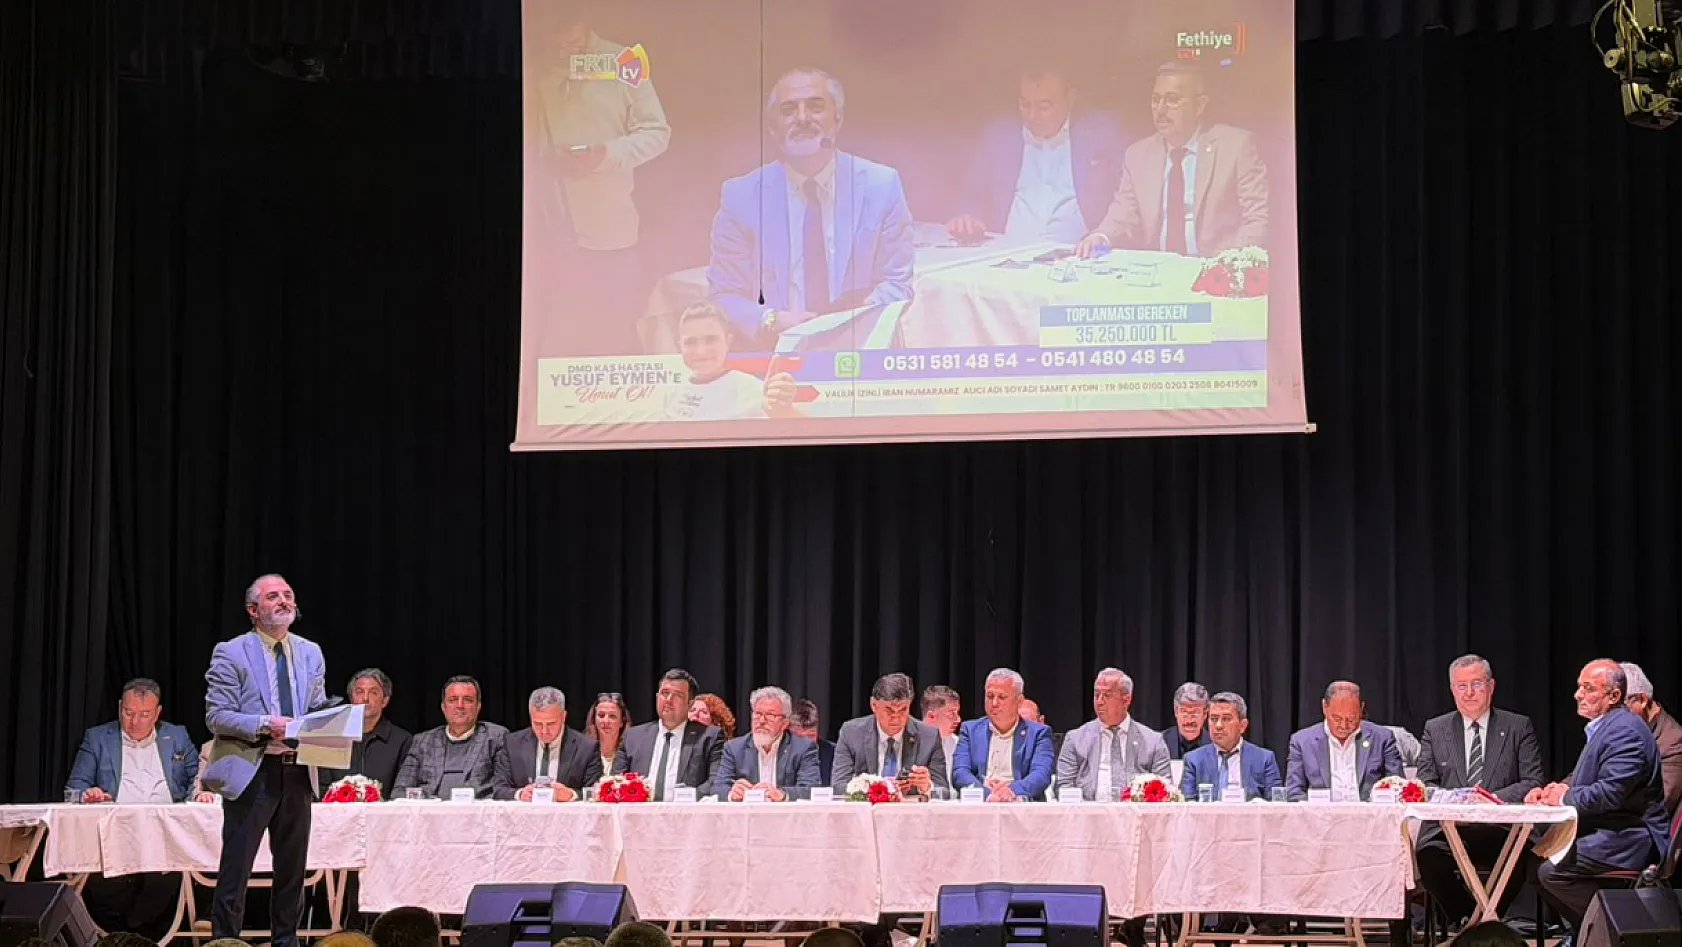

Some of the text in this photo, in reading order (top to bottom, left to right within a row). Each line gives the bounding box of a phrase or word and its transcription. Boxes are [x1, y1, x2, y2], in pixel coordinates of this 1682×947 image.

[1177, 30, 1233, 49] Fethiye
[569, 53, 640, 80] FRT tv
[1065, 305, 1188, 322] TOPLANMASI GEREKEN
[1076, 325, 1178, 344] 35.250.000 TL
[568, 365, 592, 374] DMD
[618, 362, 664, 372] HASTASI
[883, 355, 925, 371] 0531
[930, 354, 961, 370] 581
[964, 353, 990, 368] 48
[994, 352, 1020, 368] 54
[1041, 351, 1085, 367] 0541
[1089, 350, 1126, 366] 480
[1131, 349, 1156, 365] 48
[1161, 348, 1186, 364] 54
[550, 372, 605, 387] YUSUF
[1005, 385, 1037, 393] SOYADI
[1040, 384, 1069, 392] SAMET
[1071, 383, 1099, 392] AYDIN
[1105, 383, 1116, 391] TR
